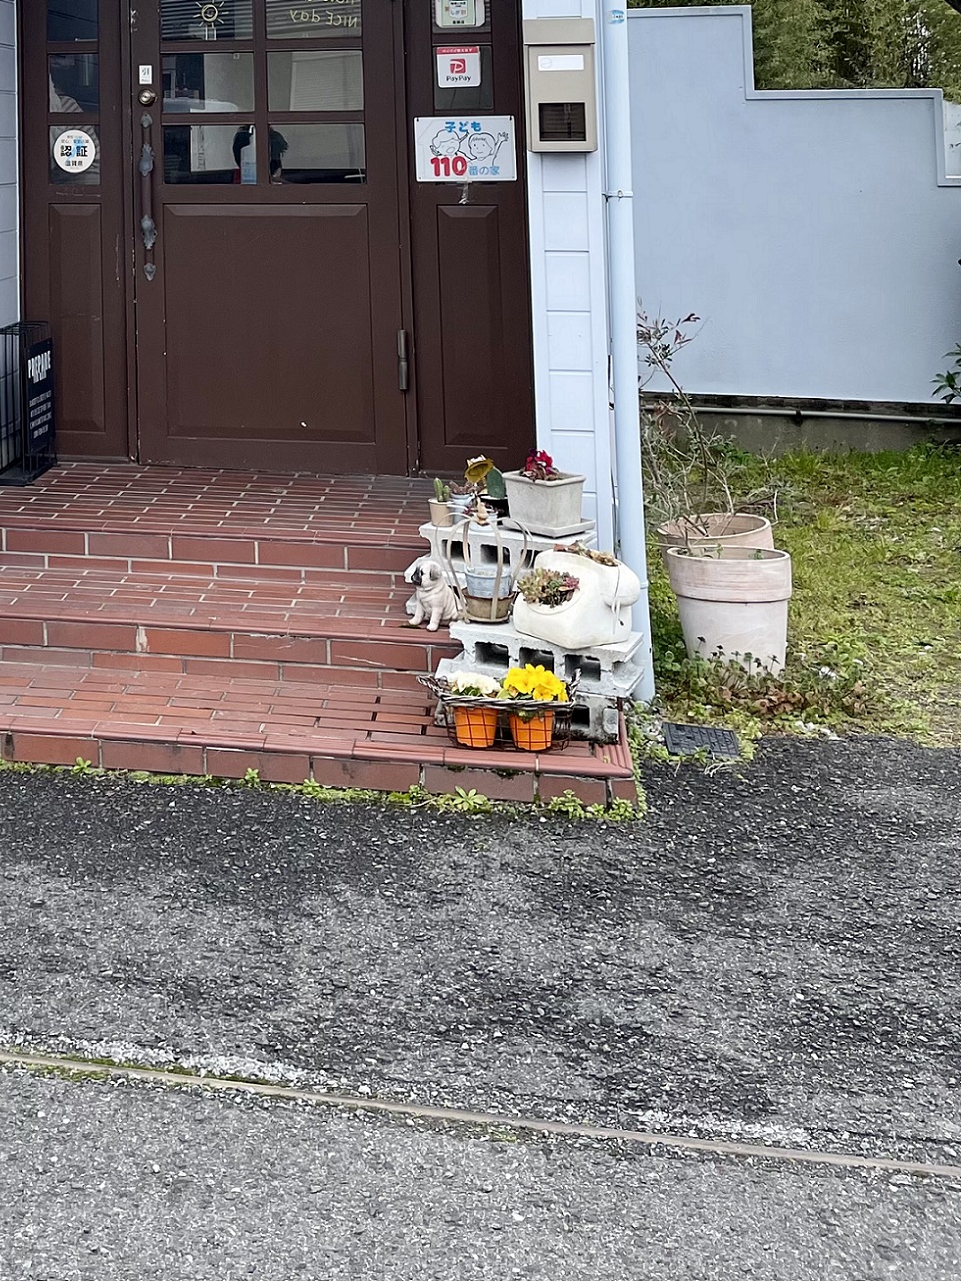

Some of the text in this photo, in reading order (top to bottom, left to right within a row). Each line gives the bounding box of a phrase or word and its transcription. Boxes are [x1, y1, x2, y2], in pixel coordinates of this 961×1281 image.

[445, 121, 482, 133] 子ども
[60, 145, 88, 157] 認証
